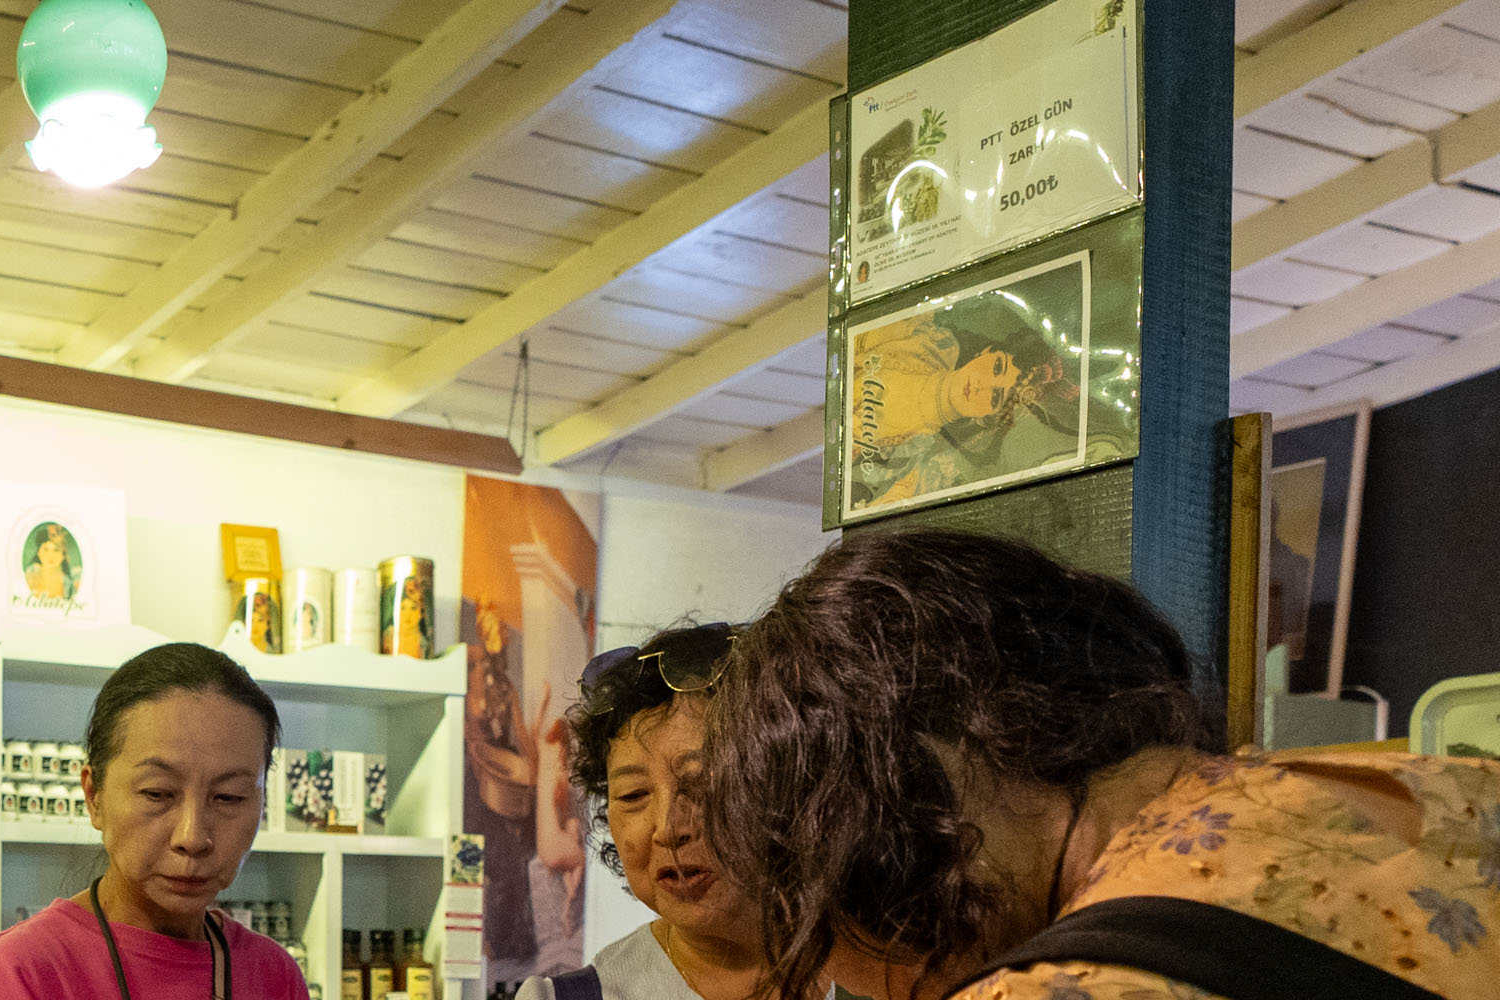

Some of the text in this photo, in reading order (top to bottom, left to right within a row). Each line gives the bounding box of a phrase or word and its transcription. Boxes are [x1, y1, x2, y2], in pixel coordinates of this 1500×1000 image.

[980, 98, 1073, 150] PTT ÖZEL GÜN
[1000, 175, 1059, 211] 50,00₺
[852, 373, 885, 475] Adatepe
